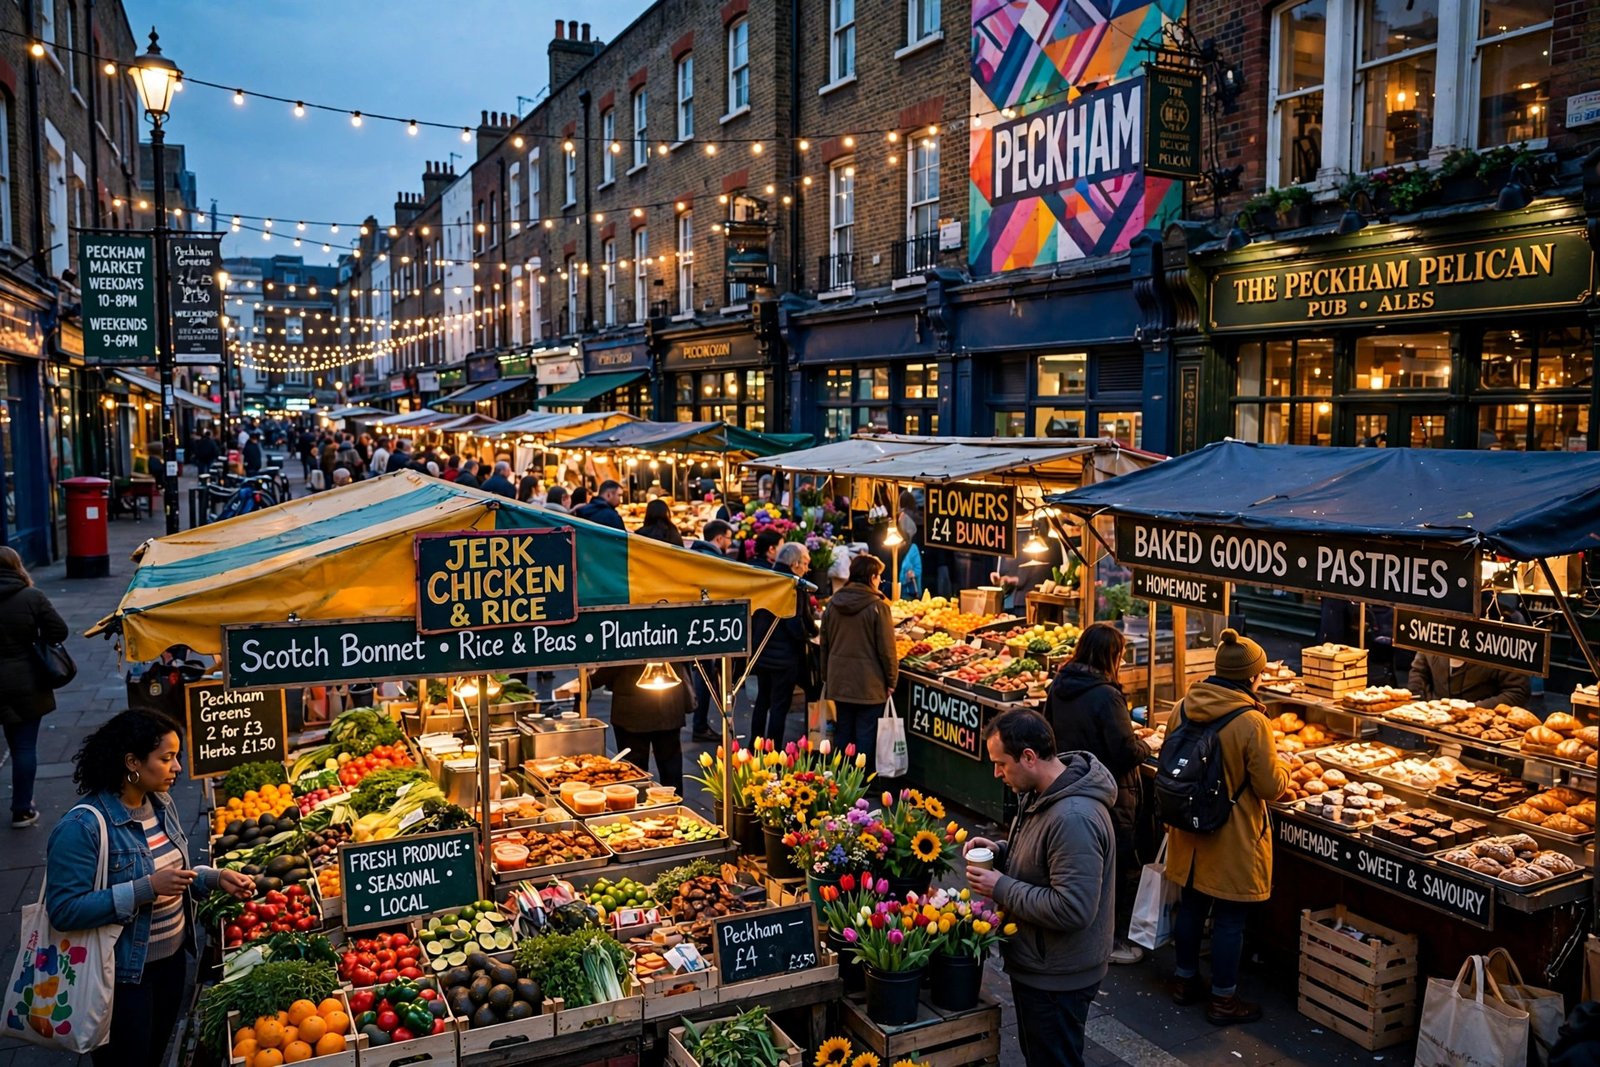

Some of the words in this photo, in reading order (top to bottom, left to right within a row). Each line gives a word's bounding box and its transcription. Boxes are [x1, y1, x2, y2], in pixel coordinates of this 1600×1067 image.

[995, 84, 1141, 198] PECKHAM
[86, 245, 145, 259] PECKHAM
[178, 255, 211, 266] Greens
[90, 261, 143, 274] MARKET
[1233, 275, 1278, 304] THE
[1284, 259, 1409, 299] PECKHAM
[1418, 242, 1555, 285] PELICAN
[89, 278, 144, 290] WEEKDAYS
[98, 294, 137, 307] 10-8PM
[1307, 299, 1348, 318] PUB
[1377, 291, 1435, 313] ALES
[90, 317, 148, 331] WEEKENDS
[103, 334, 138, 347] 9-6PM
[928, 488, 1009, 522] FLOWERS
[931, 517, 952, 542] £4
[956, 520, 1006, 550] BUNCH
[445, 535, 535, 571] JERK
[1134, 525, 1203, 564] BAKED
[1210, 534, 1288, 577] GOODS
[1316, 546, 1449, 599] PASTRIES
[427, 564, 565, 605] CHICKEN
[1146, 574, 1208, 603] HOMEMADE
[450, 603, 471, 627] &
[482, 596, 547, 625] RICE
[240, 636, 329, 673] Scotch
[340, 632, 426, 667] Bonnet
[458, 630, 504, 660] Rice
[514, 631, 526, 654] &
[532, 626, 577, 654] Peas
[600, 620, 678, 650] Plantain
[686, 618, 743, 646] £5.50
[1409, 618, 1456, 649] SWEET
[1460, 628, 1470, 650] &
[1475, 630, 1538, 664] SAVOURY
[199, 690, 265, 707] Peckham
[913, 684, 979, 729] FLOWERS
[200, 707, 251, 722] Greens
[206, 726, 216, 741] 2
[221, 724, 240, 739] for
[244, 720, 263, 737] £3
[912, 710, 930, 734] £4
[933, 716, 975, 752] BUNCH
[200, 742, 236, 760] Herbs
[242, 737, 276, 754] £1.50
[350, 848, 397, 873] FRESH
[402, 840, 462, 864] PRODUCE
[1280, 820, 1339, 862] HOMEMADE
[1357, 850, 1402, 885] SWEET
[1406, 868, 1418, 890] &
[1422, 874, 1486, 916] SAVOURY
[368, 868, 440, 894] SEASONAL
[380, 894, 429, 917] LOCAL
[723, 920, 784, 946] Peckham
[735, 945, 758, 972] £4
